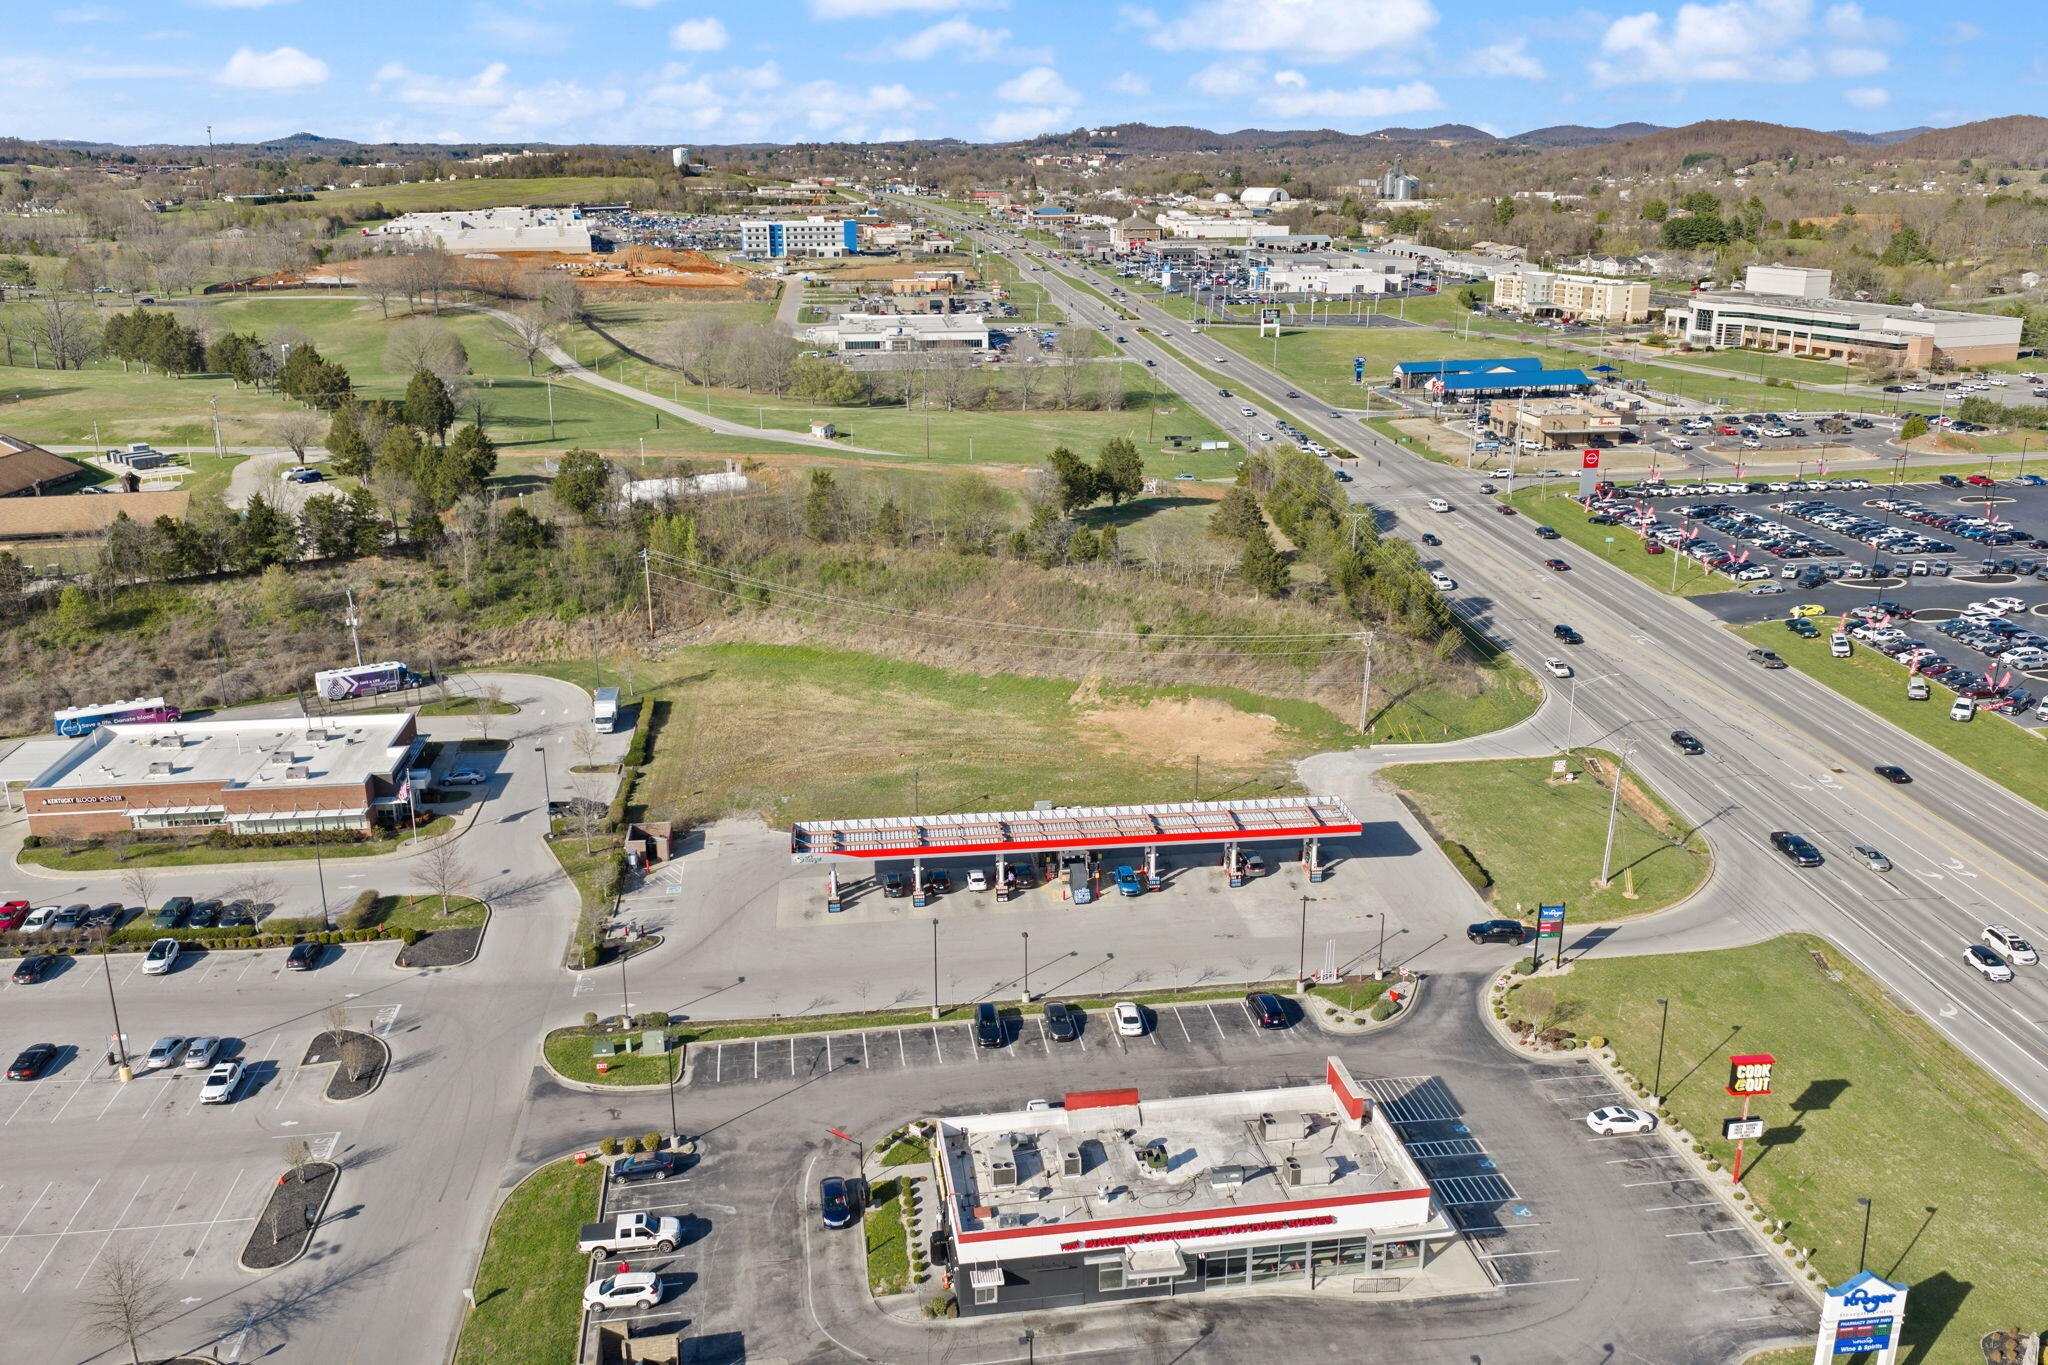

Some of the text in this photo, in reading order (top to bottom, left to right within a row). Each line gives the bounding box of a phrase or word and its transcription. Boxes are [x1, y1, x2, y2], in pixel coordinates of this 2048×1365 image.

[1736, 1063, 1772, 1079] COOK
[1746, 1077, 1770, 1092] OUT
[1084, 1236, 1140, 1248] BURGERS
[1143, 1229, 1197, 1242] CHICKEN
[1225, 1225, 1249, 1235] HOT
[1251, 1221, 1284, 1233] DOGS
[1287, 1216, 1333, 1228] SHAKES
[1843, 1288, 1896, 1313] Kroger
[1863, 1343, 1883, 1351] Spirits
